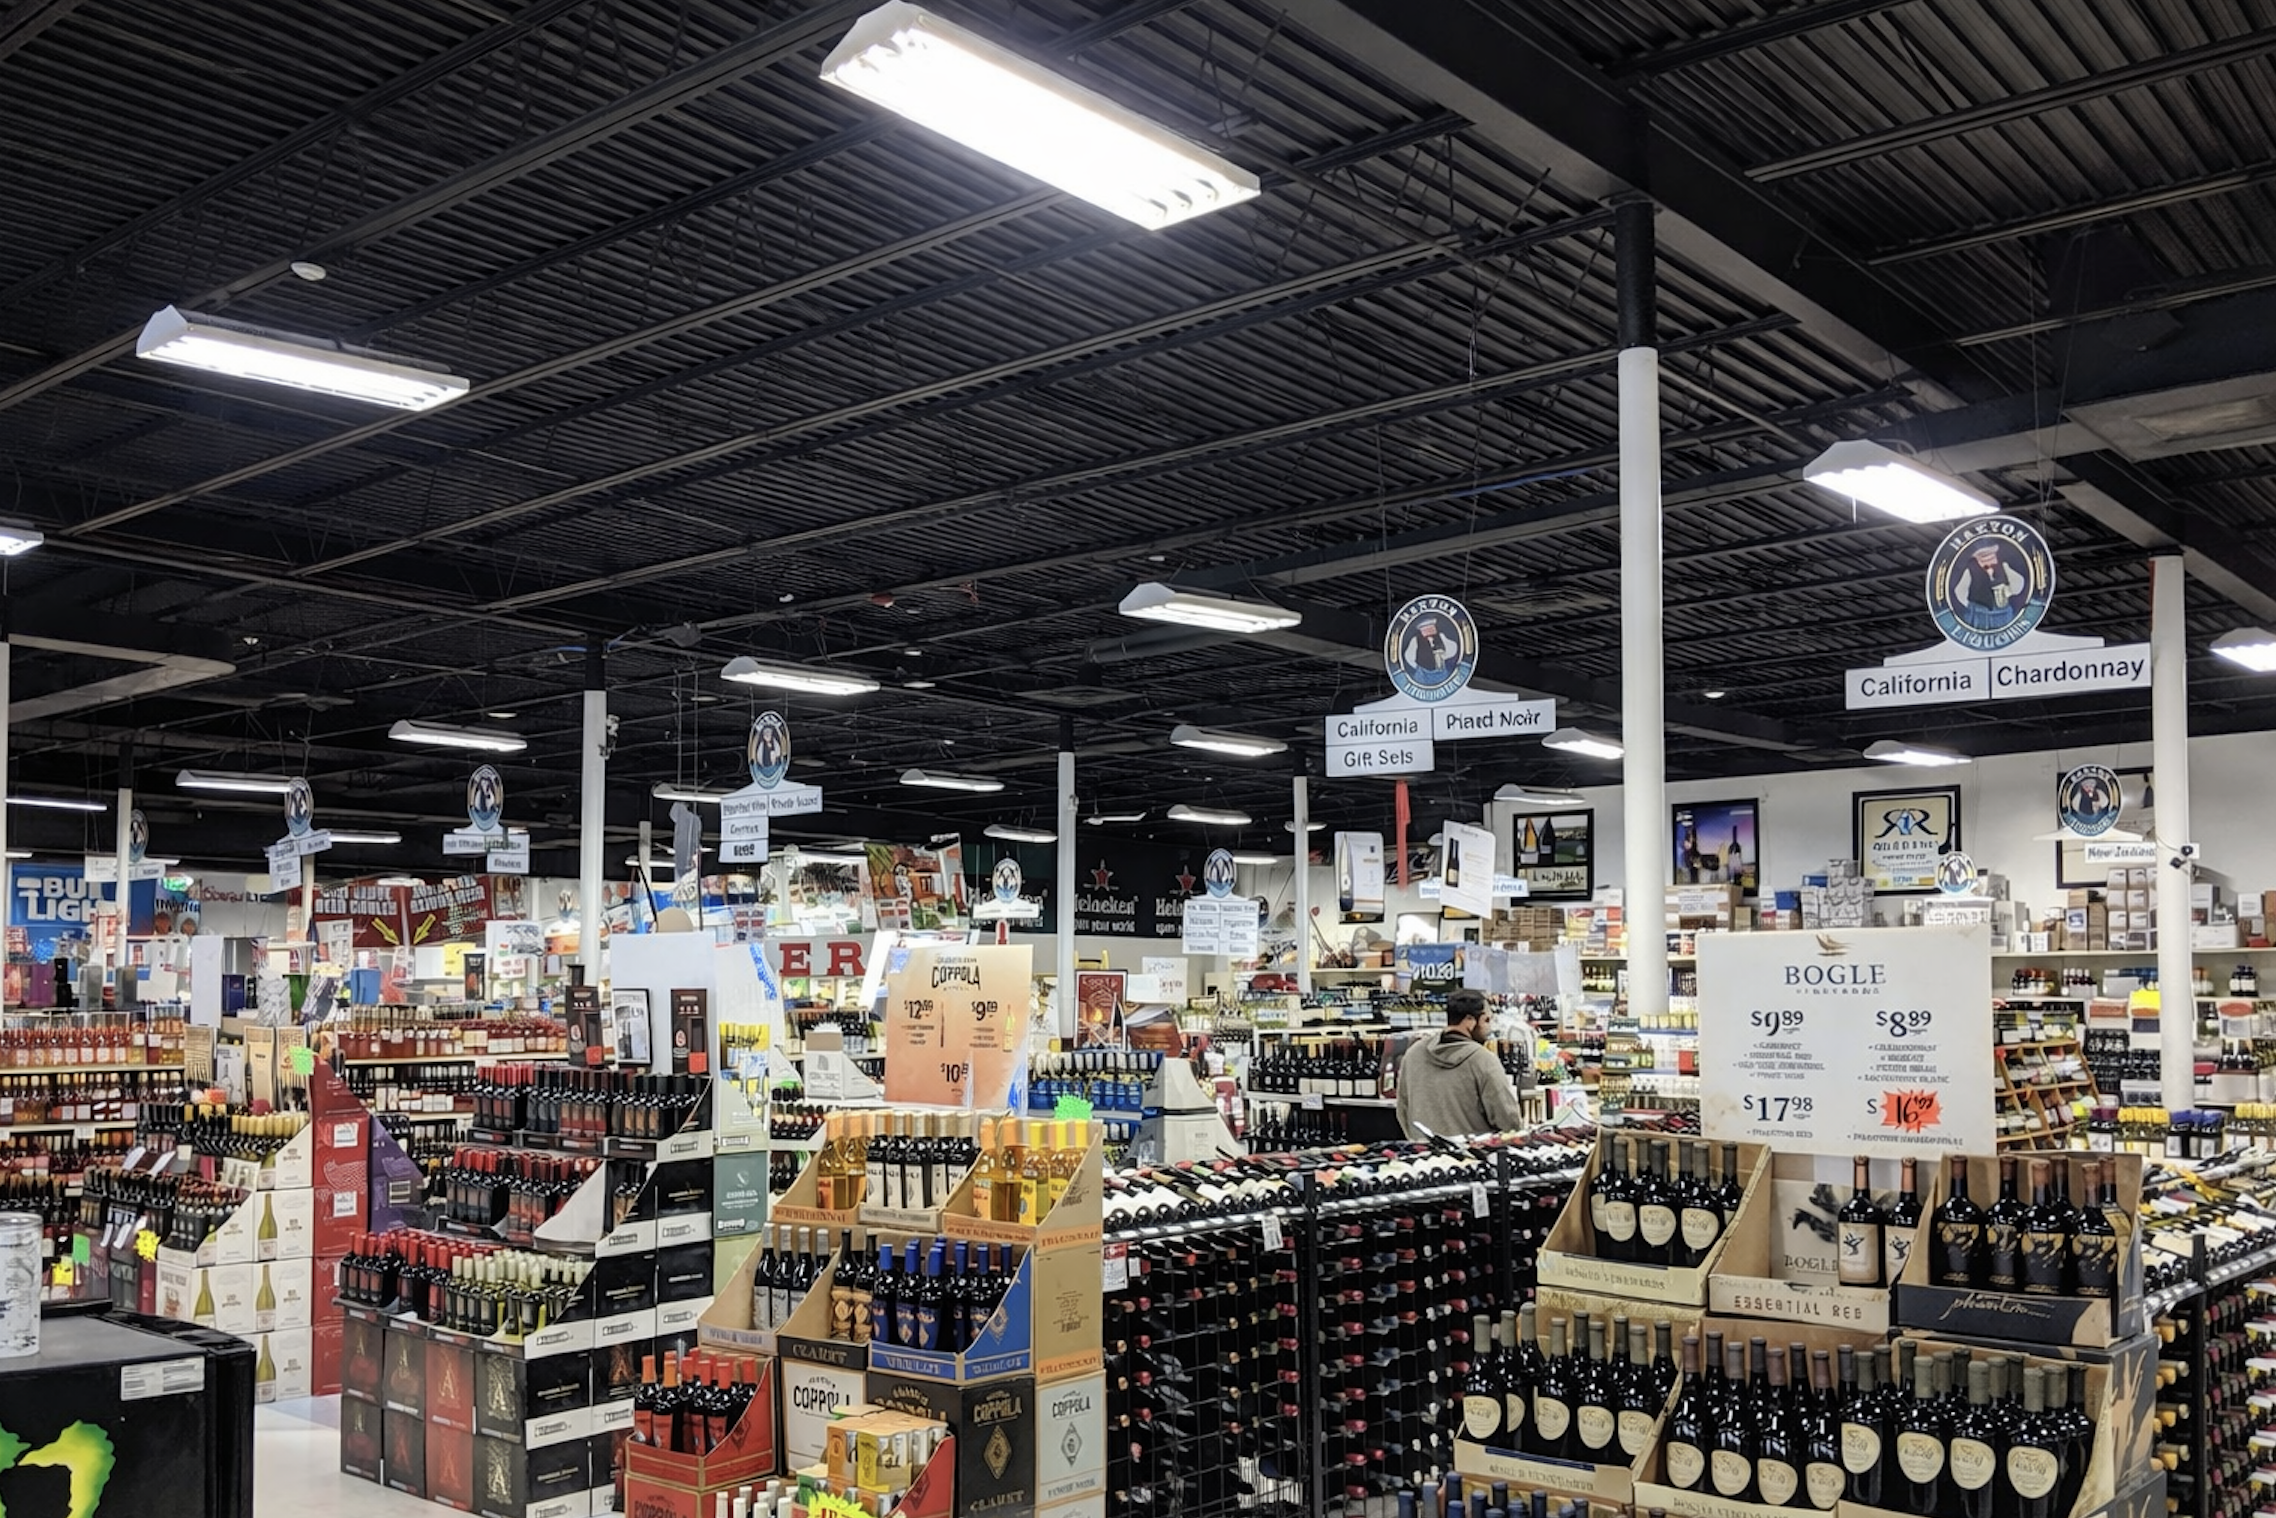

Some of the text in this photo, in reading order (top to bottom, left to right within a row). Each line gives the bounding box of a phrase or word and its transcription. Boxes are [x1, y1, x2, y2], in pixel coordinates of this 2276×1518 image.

[1861, 658, 2145, 697] California Chardonnay
[1338, 719, 1418, 738] California
[1785, 964, 1886, 986] BOGLE
